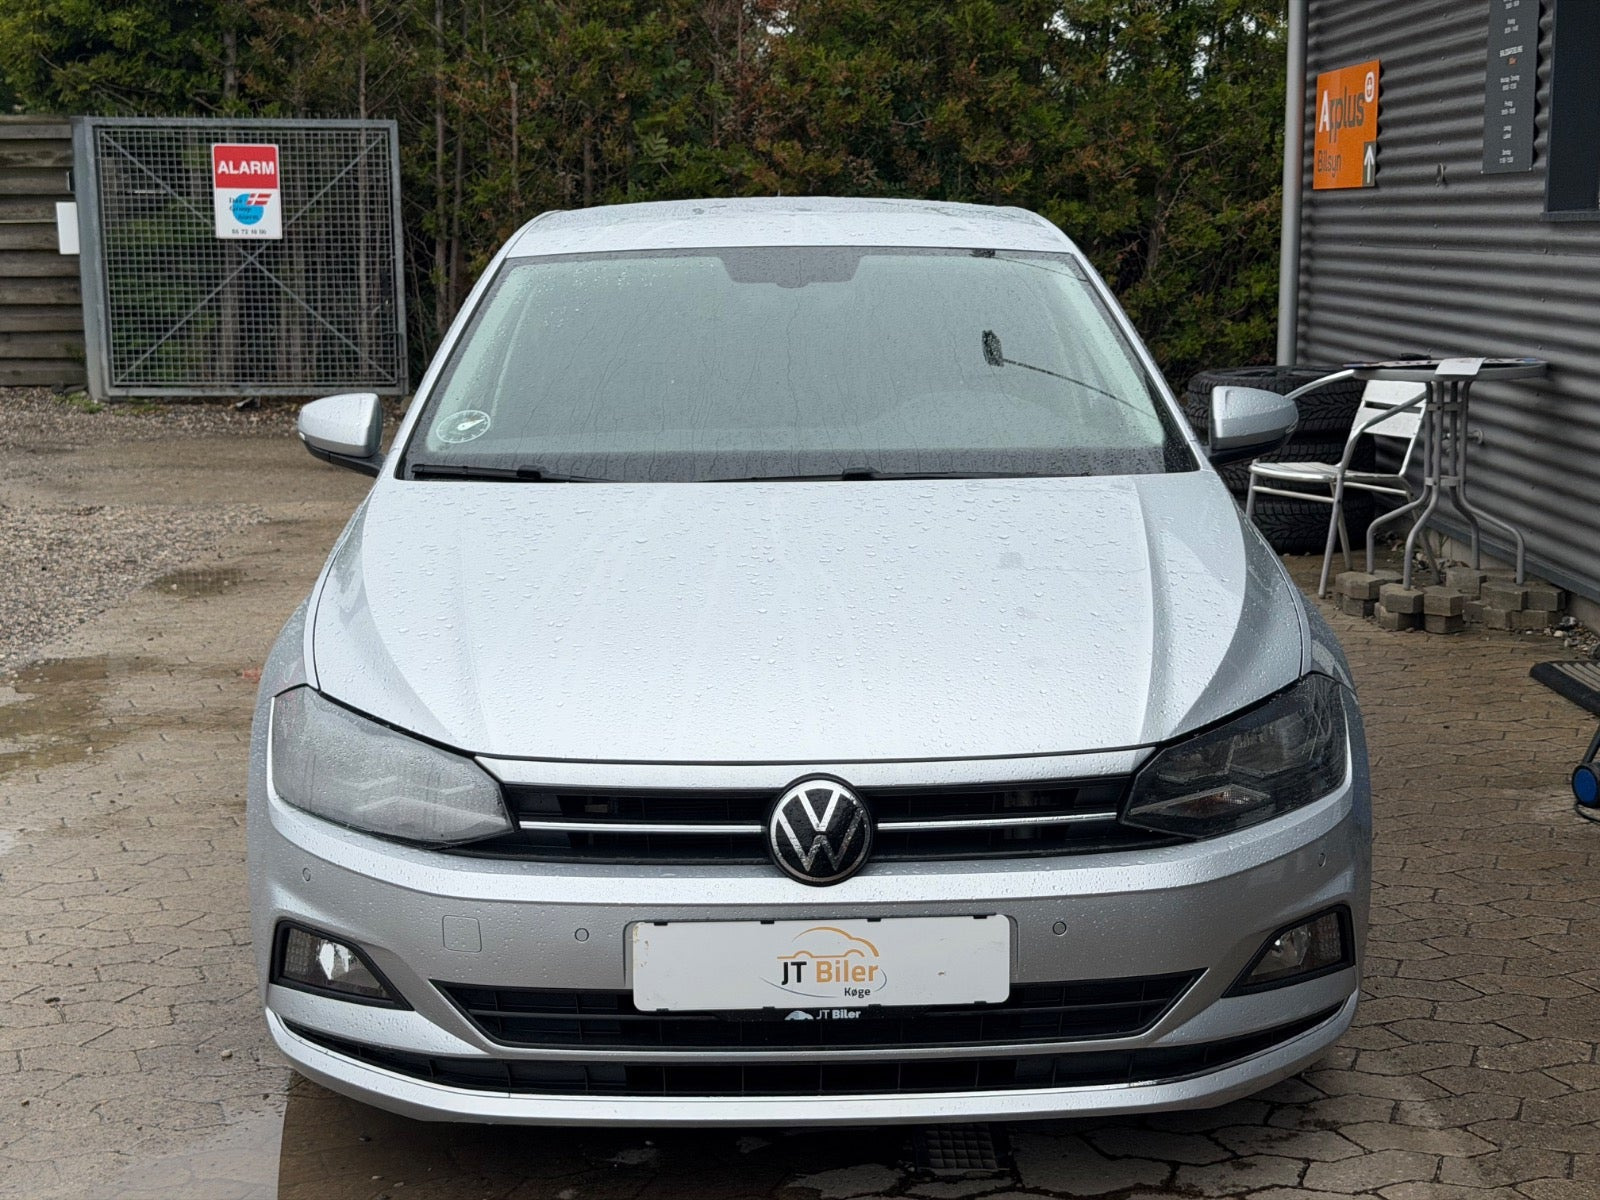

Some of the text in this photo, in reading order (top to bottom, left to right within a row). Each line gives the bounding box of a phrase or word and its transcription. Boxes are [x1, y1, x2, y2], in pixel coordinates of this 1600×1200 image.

[217, 160, 275, 175] ALARM
[1318, 149, 1342, 178] Bilsyn
[781, 959, 879, 986] JT Biler
[844, 986, 872, 999] Køge
[816, 1008, 862, 1020] JT Biler
